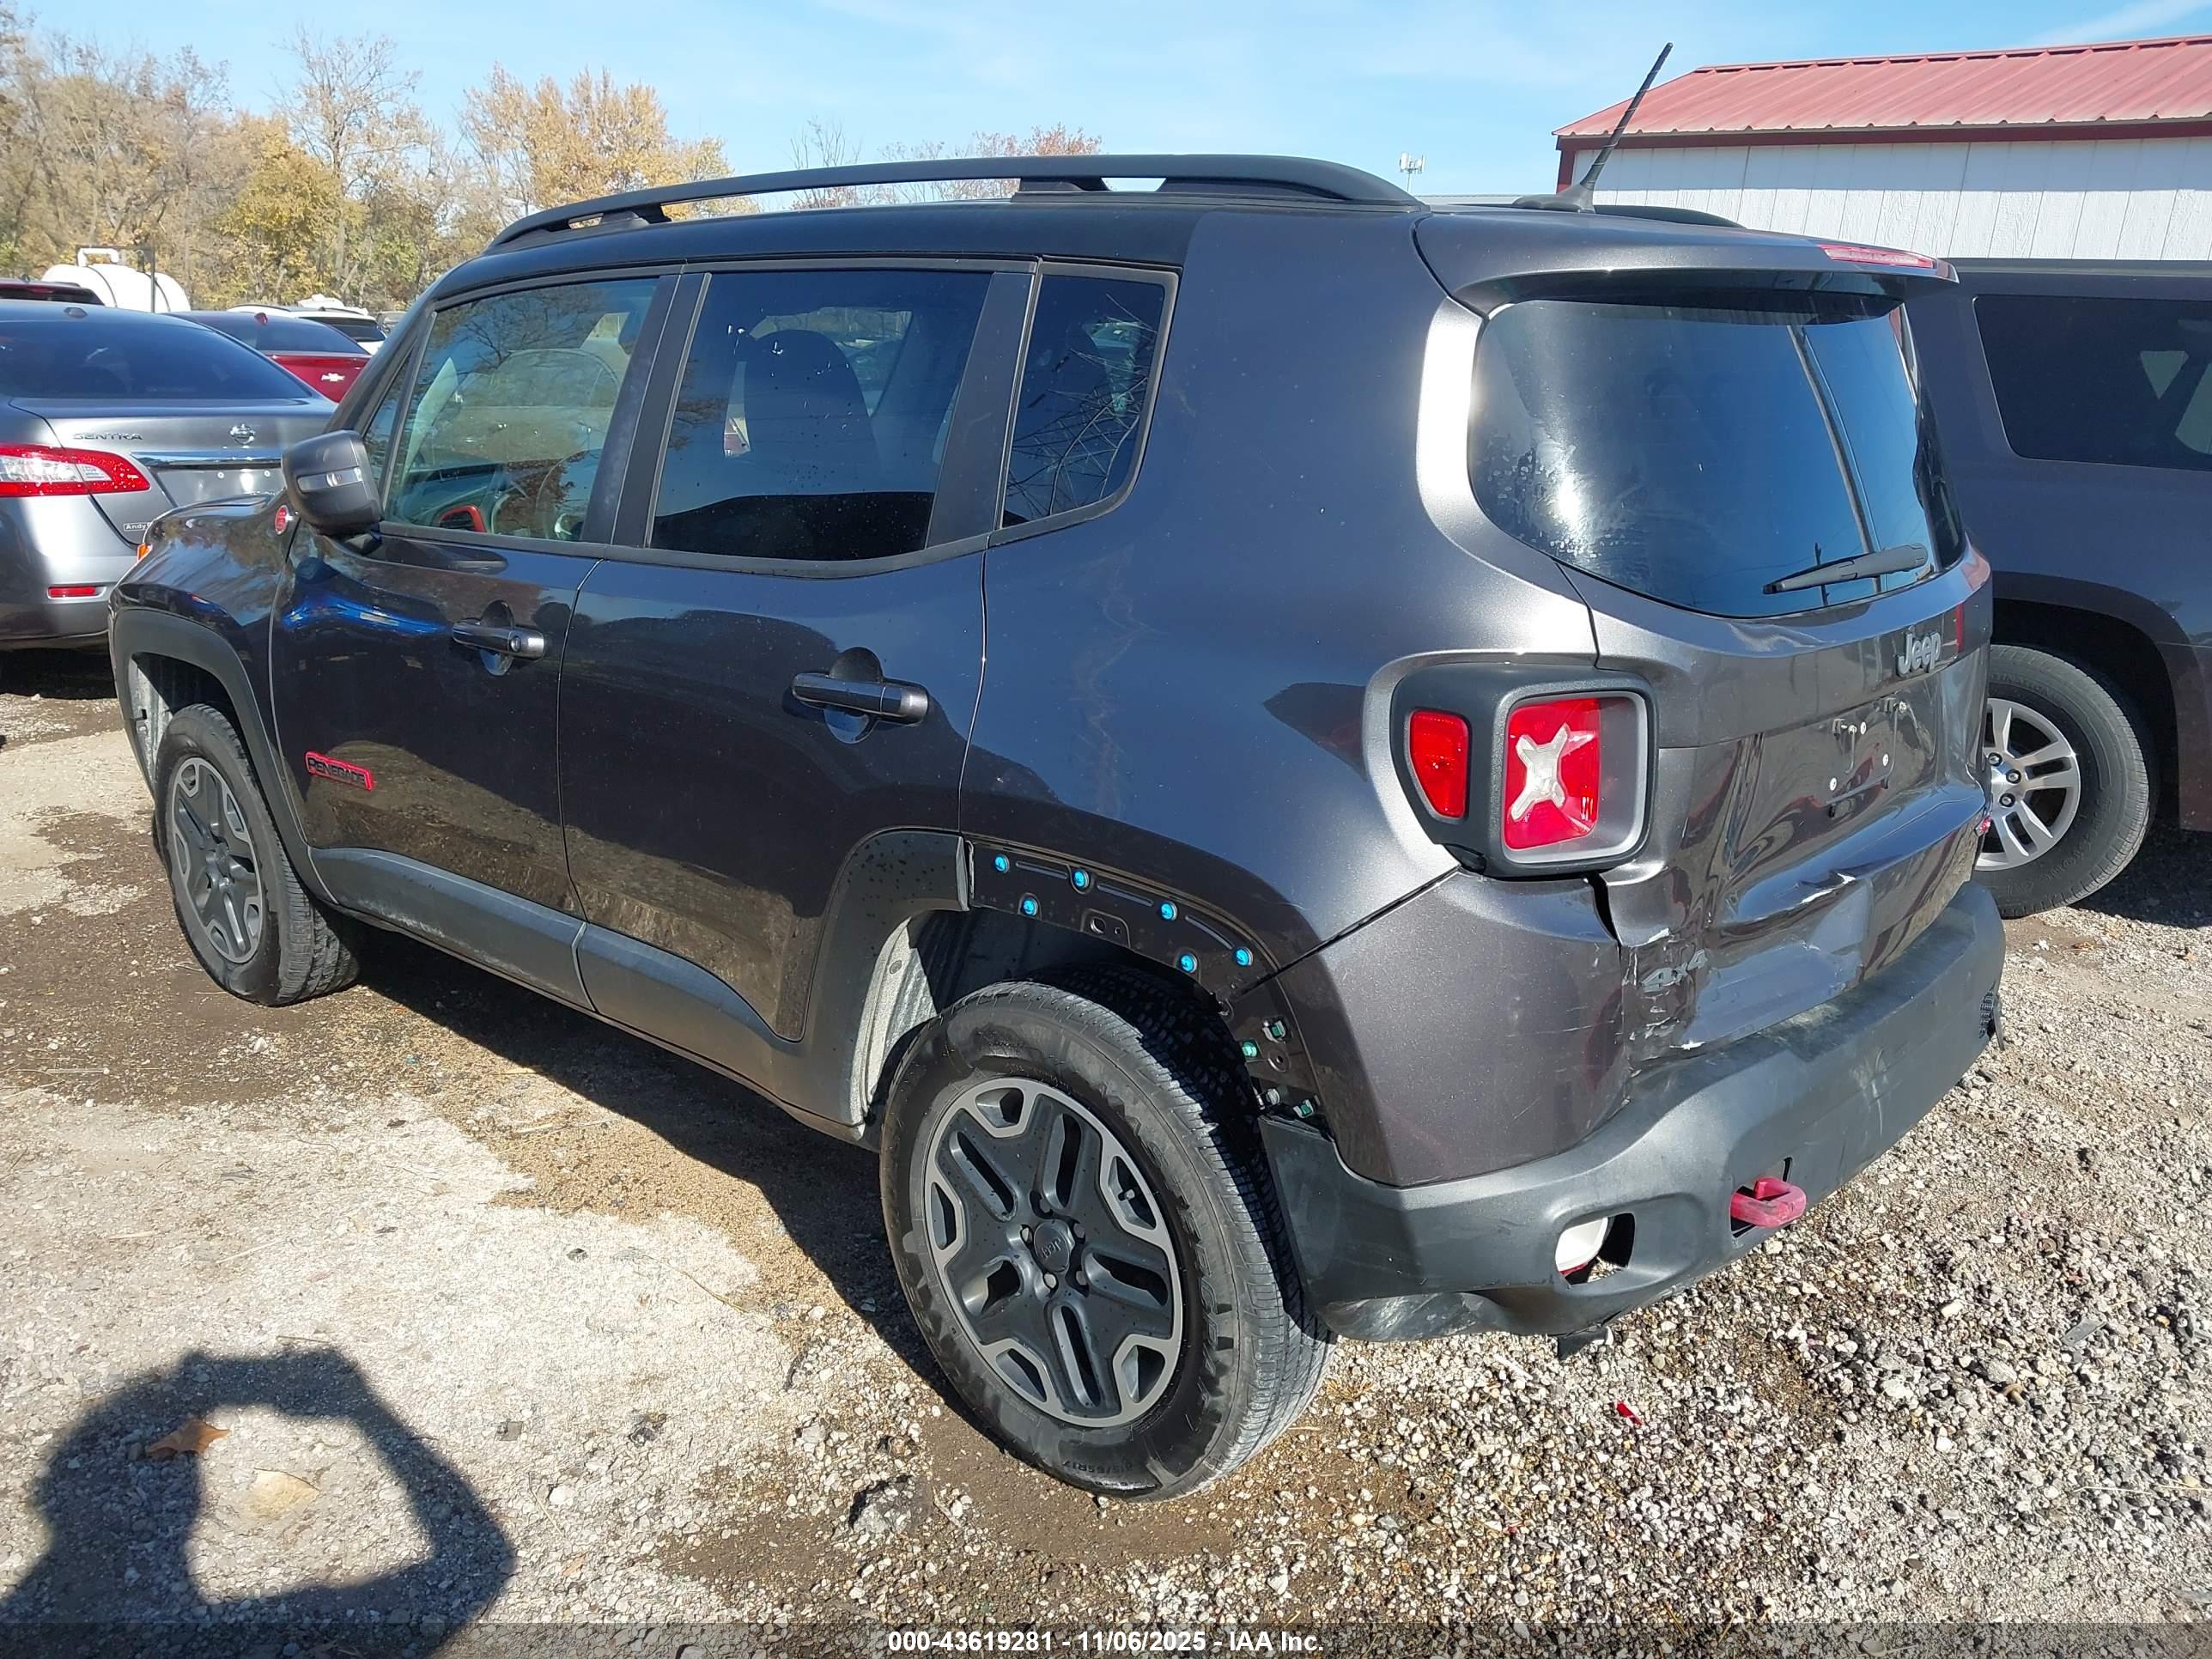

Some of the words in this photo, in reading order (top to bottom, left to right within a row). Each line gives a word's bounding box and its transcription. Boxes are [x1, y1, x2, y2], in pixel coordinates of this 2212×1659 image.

[72, 432, 143, 441] SENTRA
[1896, 632, 1942, 676] Jeep
[307, 757, 367, 786] RENEGADE
[1641, 949, 1709, 993] 4x4
